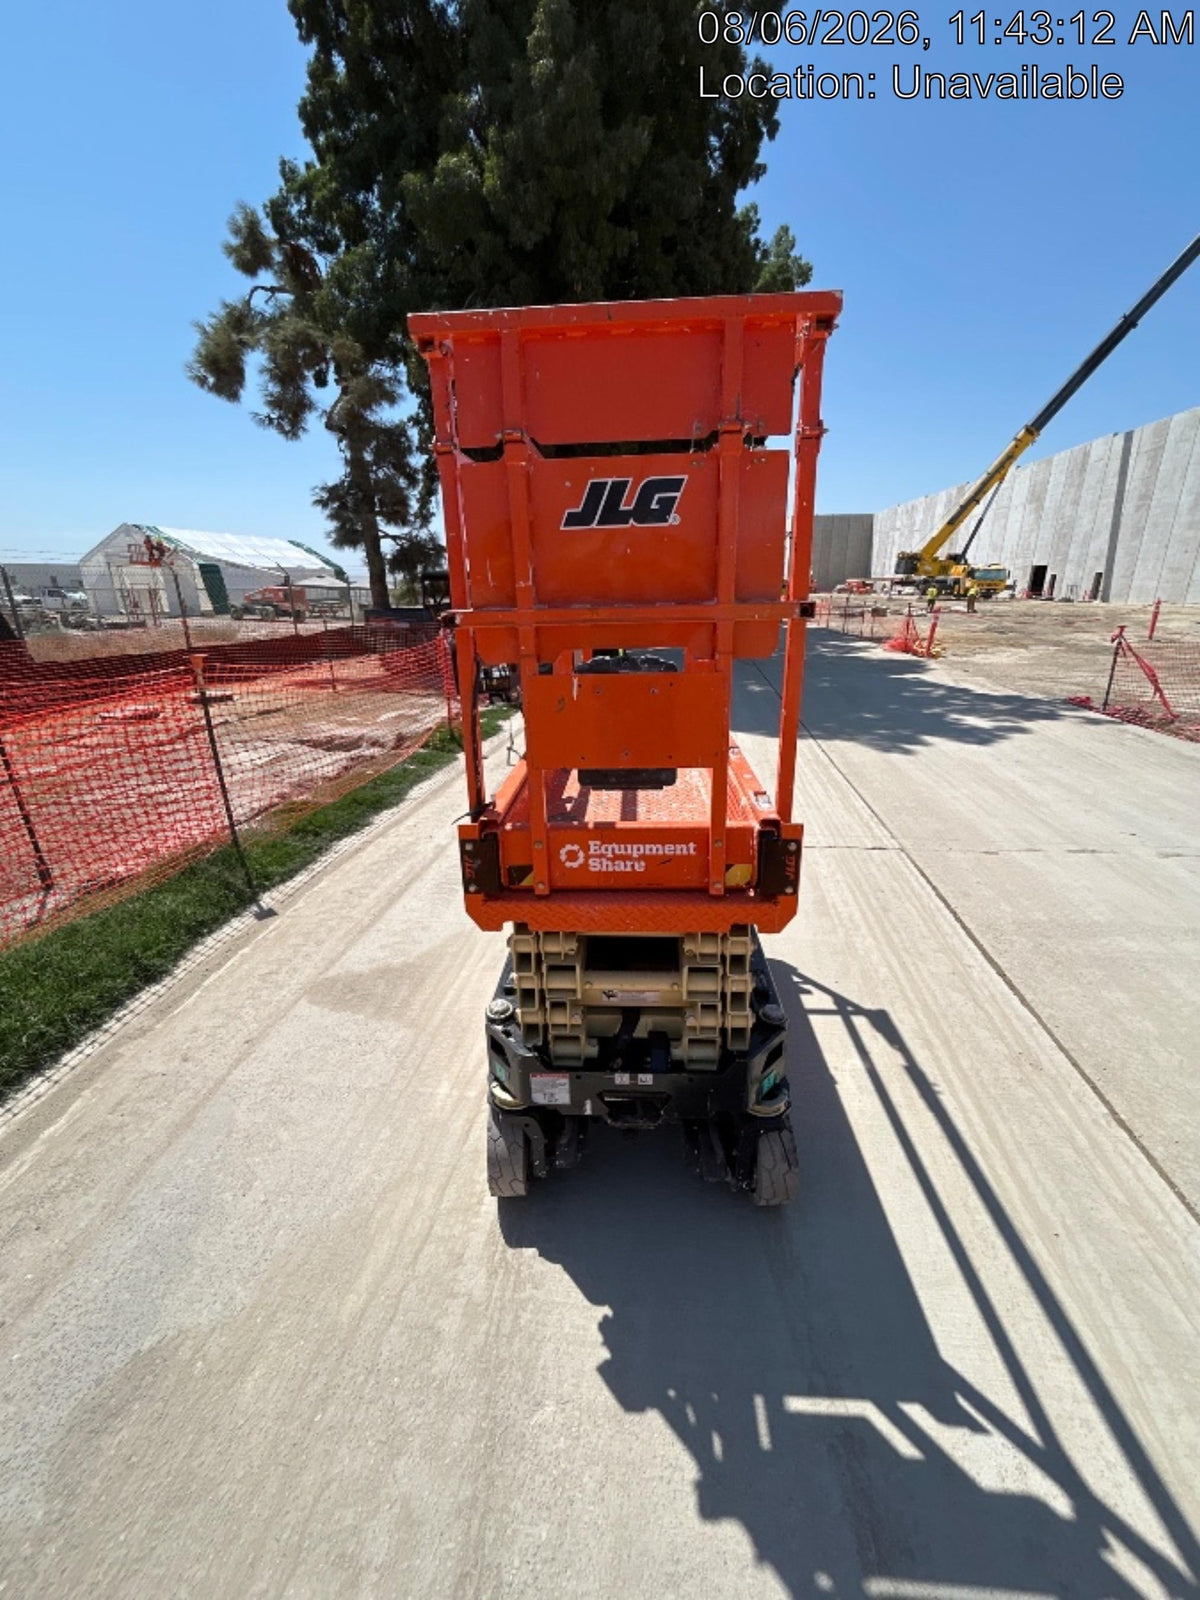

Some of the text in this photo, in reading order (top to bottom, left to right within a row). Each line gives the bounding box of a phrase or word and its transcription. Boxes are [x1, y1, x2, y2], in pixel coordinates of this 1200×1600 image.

[560, 474, 688, 531] JLG
[588, 840, 697, 857] Equipment
[588, 857, 646, 872] Share
